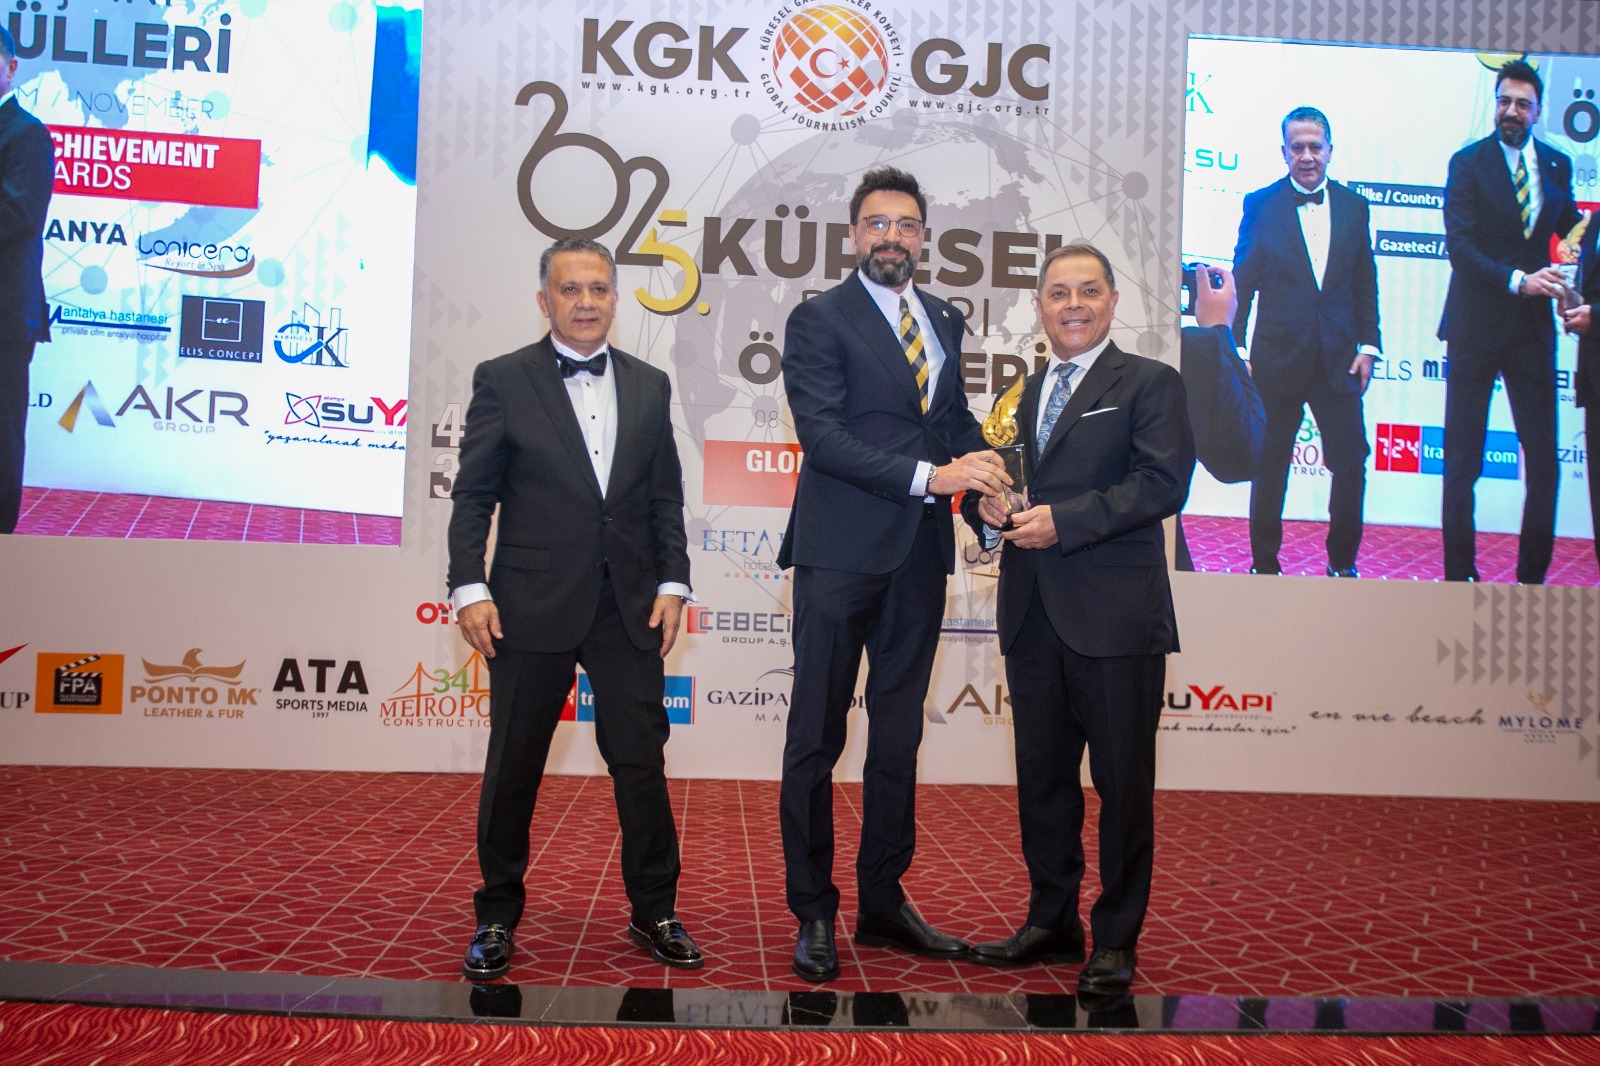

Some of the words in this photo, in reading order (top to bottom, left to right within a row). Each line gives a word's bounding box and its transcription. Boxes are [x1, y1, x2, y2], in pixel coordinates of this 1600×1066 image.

[760, 6, 792, 51] KÜRESEL
[873, 10, 903, 57] KONSEYİ
[582, 18, 750, 83] KGK
[910, 37, 1050, 101] GJC
[581, 80, 750, 99] www.kgk.org.tr
[75, 90, 214, 119] NOVEMBER
[760, 73, 789, 114] GLOBAL
[791, 112, 866, 131] JOURNALISM
[869, 76, 901, 118] COUNCIL
[909, 99, 1049, 117] www.gjc.org.tr
[1195, 148, 1238, 171] SU
[1392, 191, 1444, 209] Country
[44, 219, 127, 246] ANYA
[138, 230, 250, 262] Lonicera
[1379, 239, 1437, 255] Gazeteci
[63, 307, 106, 322] antalya
[110, 310, 168, 324] hastanesi
[180, 346, 203, 357] ELIS
[209, 348, 261, 360] CONCEPT
[115, 384, 250, 426] AKR
[153, 421, 215, 434] GROUP
[754, 409, 779, 429] 08
[701, 529, 785, 556] EFTA
[722, 636, 764, 645] GROUP
[60, 677, 98, 694] FPA
[273, 658, 369, 694] ATA
[432, 668, 470, 693] 34
[130, 686, 218, 704] PONTO
[227, 687, 258, 705] MK
[276, 699, 323, 710] SPORTS
[327, 700, 368, 712] MEDIA
[1162, 685, 1272, 712] UYAPI
[144, 708, 202, 718] LEATHER
[206, 709, 214, 718] &
[218, 709, 244, 719] FUR
[1406, 705, 1486, 725] beach
[1499, 715, 1583, 729] MYLOME
